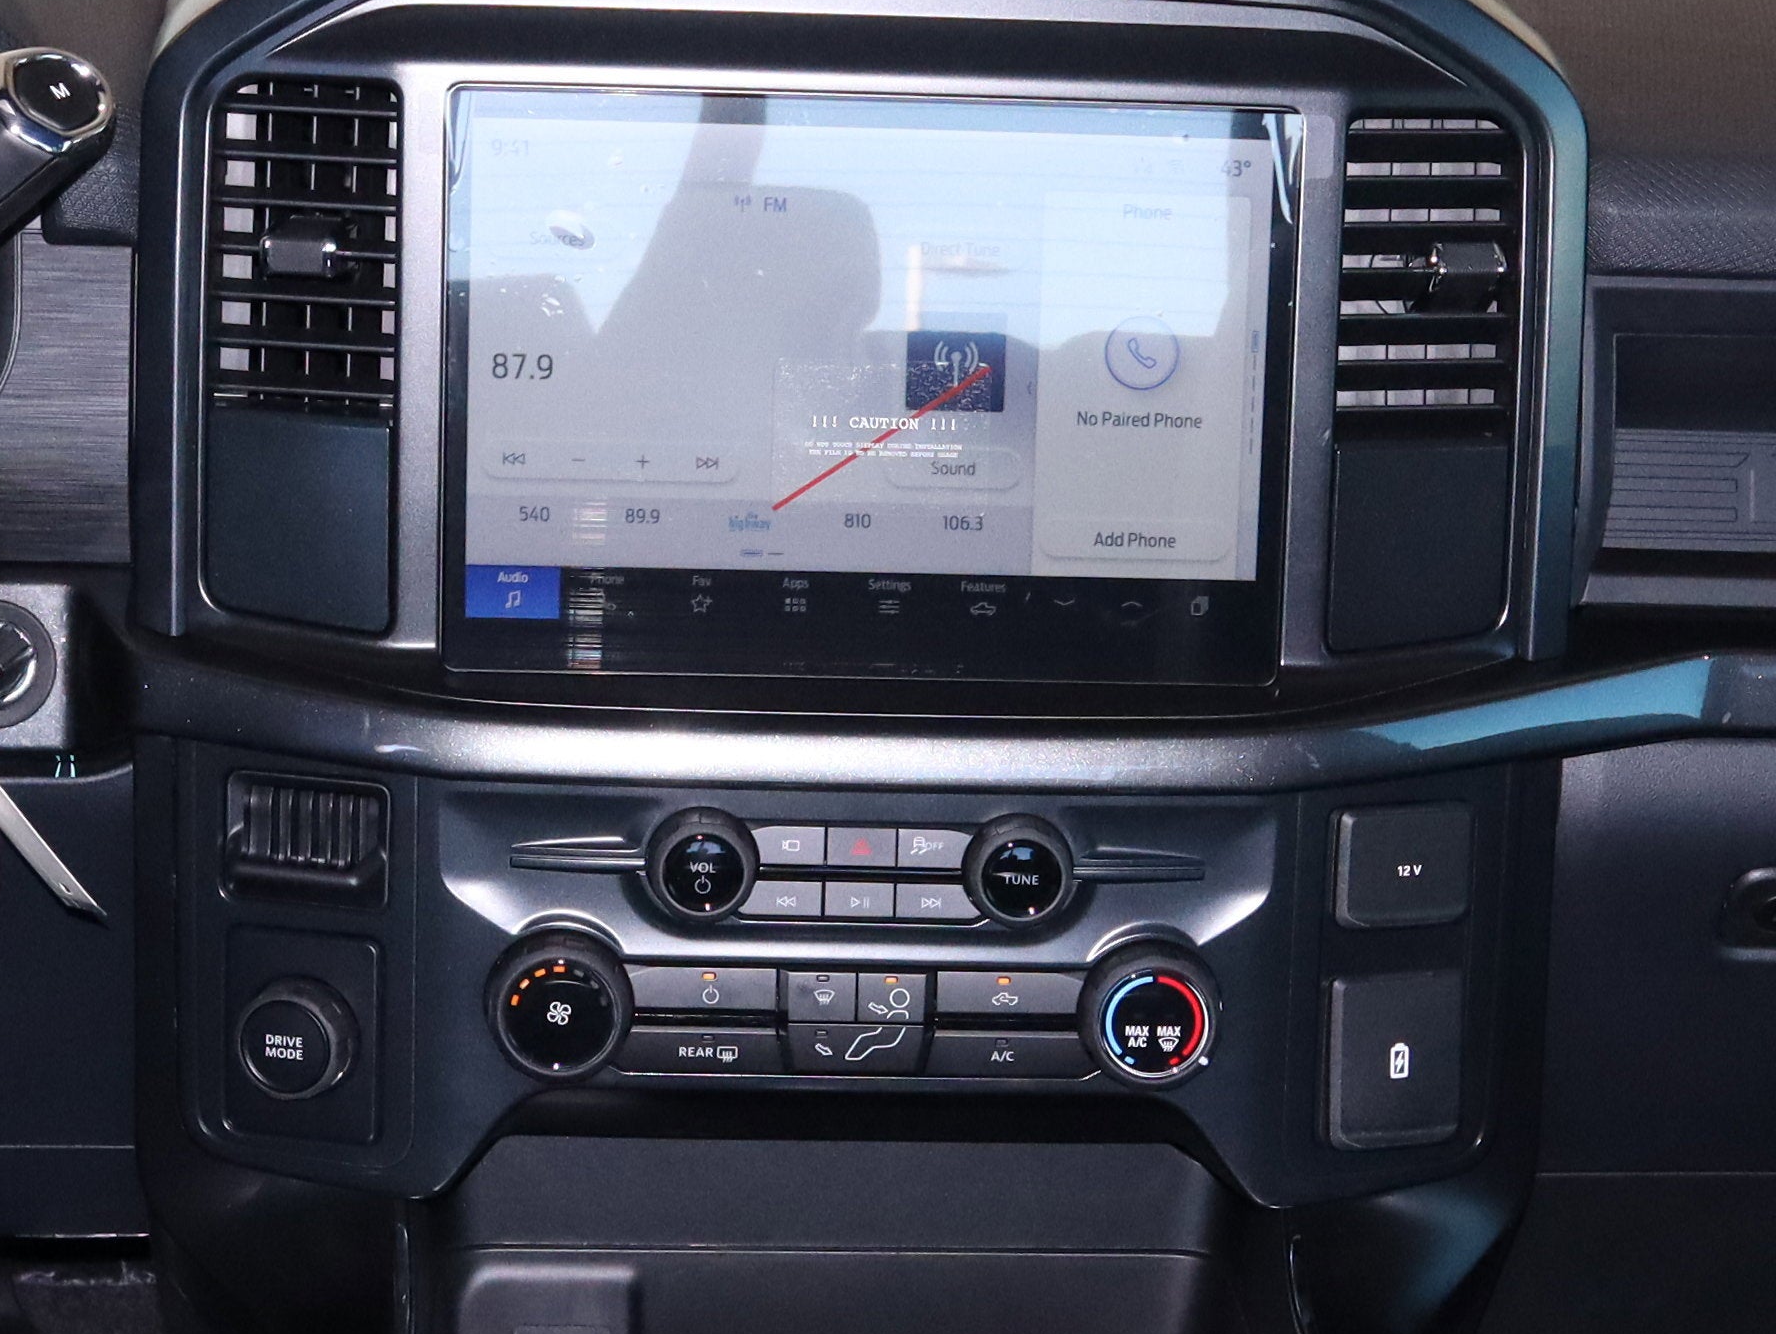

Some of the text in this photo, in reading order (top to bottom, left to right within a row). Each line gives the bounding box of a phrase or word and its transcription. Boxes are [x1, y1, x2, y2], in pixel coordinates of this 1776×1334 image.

[49, 82, 72, 100] M
[763, 197, 788, 213] FM
[1124, 204, 1173, 221] Phone
[530, 231, 587, 247] Sources
[920, 242, 1000, 258] Direct Tune
[492, 353, 554, 380] 87.9
[849, 417, 920, 430] CAUTION
[1077, 412, 1203, 429] No Paired Phone
[932, 461, 976, 476] Sound
[519, 506, 550, 522] 540
[625, 509, 660, 524] 89.9
[728, 516, 771, 533] highway
[843, 514, 872, 529] 810
[942, 515, 984, 531] 106.3
[1093, 532, 1177, 550] Add Phone
[497, 571, 529, 585] Audio
[692, 575, 712, 587] Fav
[782, 577, 809, 590] Apps
[868, 578, 912, 594] Settings
[960, 580, 1006, 594] Features
[925, 841, 945, 852] OFF
[689, 862, 716, 874] VOL
[1398, 865, 1422, 877] 12 V
[1004, 874, 1039, 886] TUNE
[1125, 1025, 1150, 1037] MAX
[1157, 1025, 1181, 1037] MAX
[265, 1034, 303, 1048] DRIVE
[1128, 1036, 1148, 1049] A/C
[265, 1047, 304, 1061] MODE
[679, 1046, 714, 1058] REAR
[991, 1051, 1015, 1062] A/C
